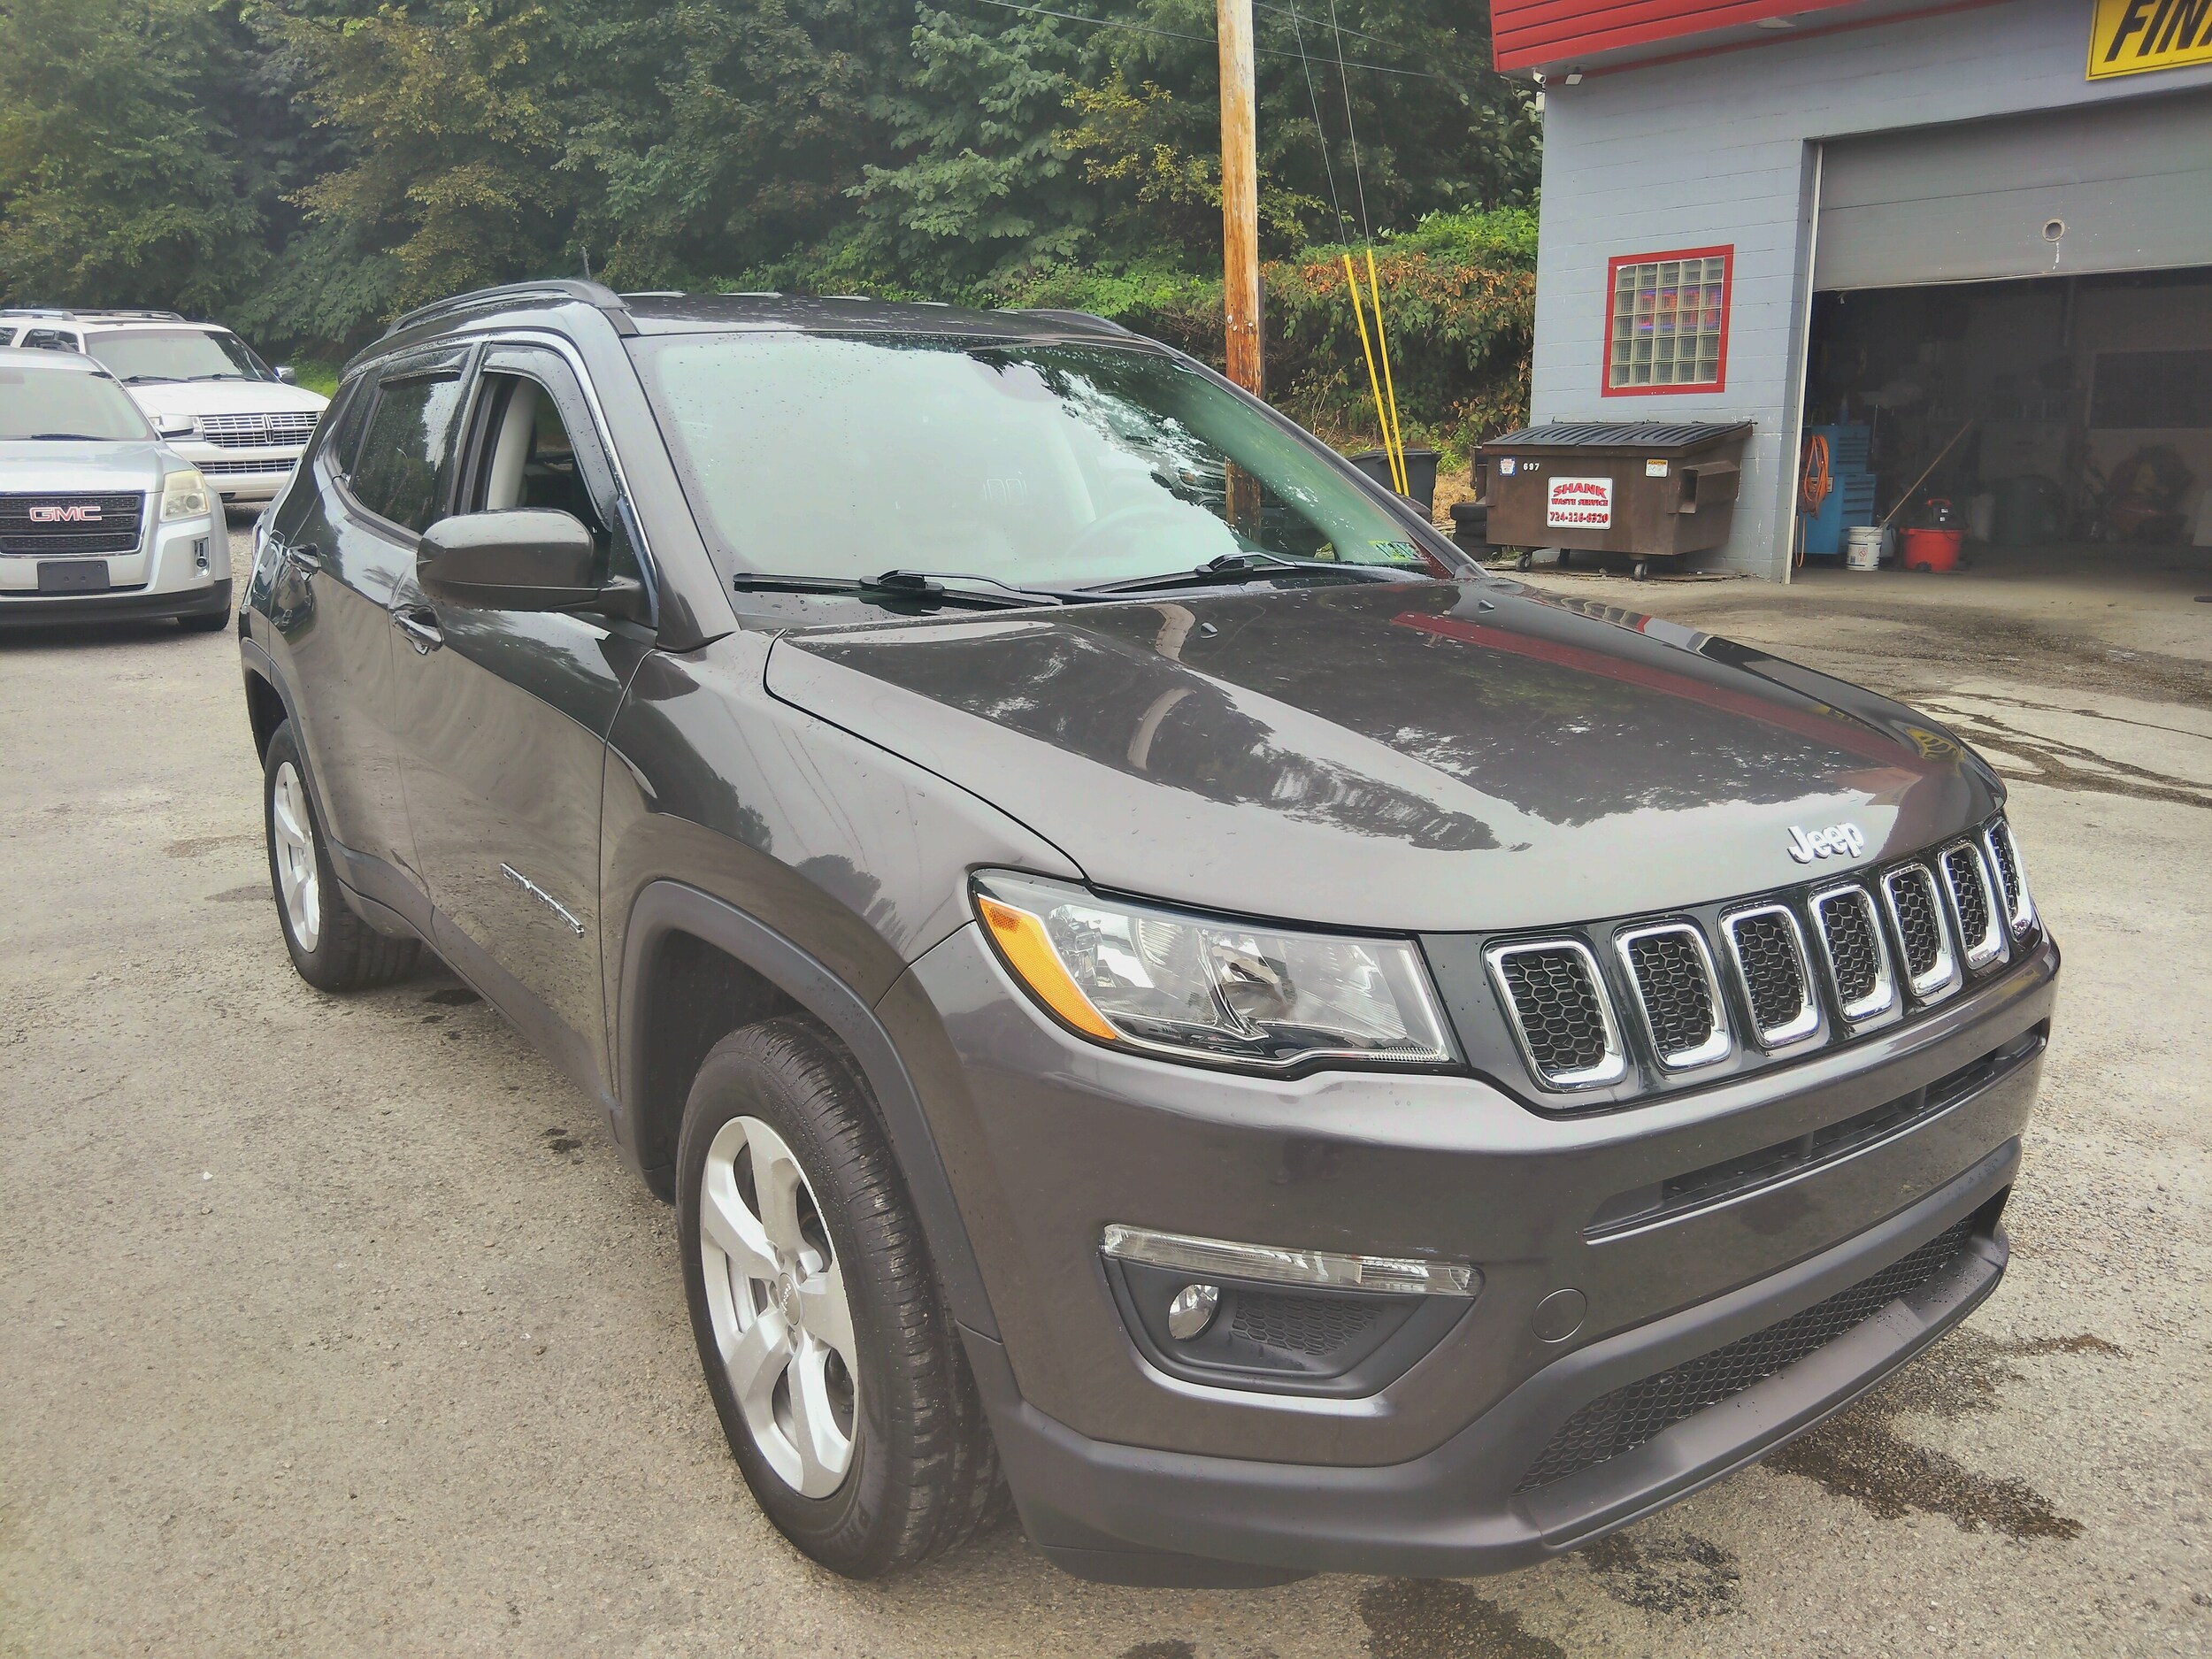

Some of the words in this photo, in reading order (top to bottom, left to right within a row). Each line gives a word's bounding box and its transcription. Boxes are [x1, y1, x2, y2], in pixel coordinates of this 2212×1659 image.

[2103, 0, 2212, 63] FIN
[1553, 482, 1607, 499] SHANK
[29, 506, 103, 522] GMC
[1786, 822, 1865, 864] Jeep
